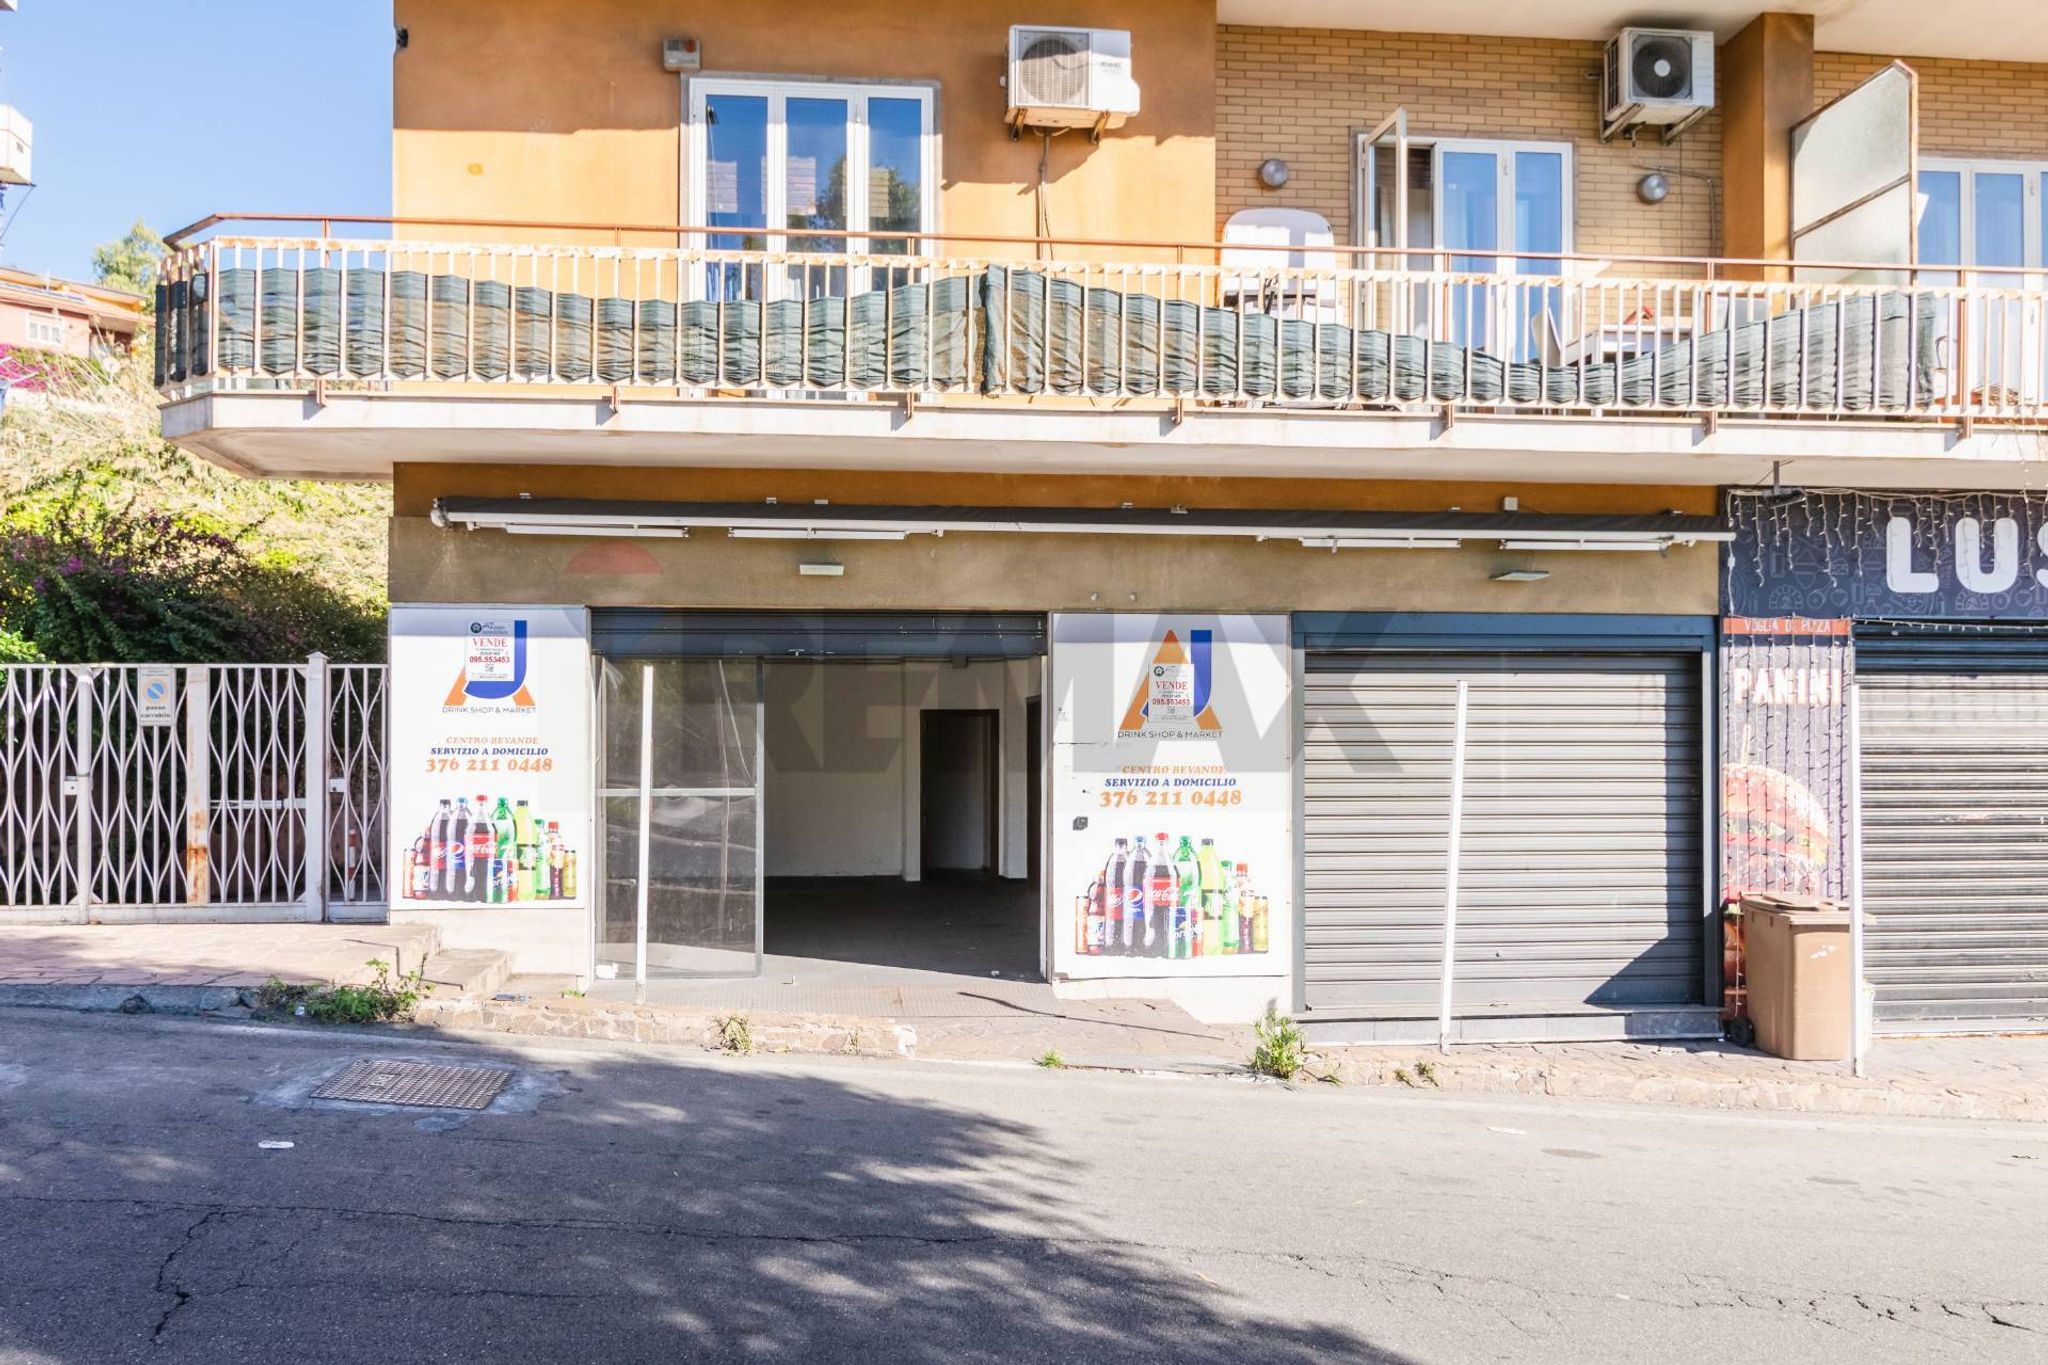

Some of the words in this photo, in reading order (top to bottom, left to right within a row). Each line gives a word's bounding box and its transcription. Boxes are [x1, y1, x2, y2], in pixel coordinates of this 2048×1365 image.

[1886, 516, 2048, 593] LU
[472, 637, 508, 647] VENDE
[1155, 681, 1188, 690] VENDE
[1734, 667, 1841, 704] PANINI
[442, 706, 468, 714] DRINK
[470, 706, 494, 714] SHOP
[495, 706, 501, 714] &
[502, 706, 537, 714] MARKET
[1117, 730, 1146, 739] DRINK
[1148, 730, 1176, 739] SHOP
[1176, 730, 1183, 739] &
[1185, 730, 1222, 739] MARKET
[446, 736, 488, 744] CENTRO
[490, 736, 539, 744] BEVANDE
[430, 747, 479, 755] SERVIZIO
[481, 747, 489, 755] A
[492, 747, 549, 755] DOMICILIO
[425, 757, 460, 772] 376
[466, 758, 500, 771] 211
[507, 757, 553, 772] 0448
[1121, 765, 1169, 774] CENTRO
[1172, 765, 1226, 774] BEVANDE
[1104, 778, 1159, 787] SERVIZIO
[1162, 778, 1170, 787] A
[1173, 778, 1237, 787] DOMICILIO
[1099, 790, 1138, 808] 376
[1145, 790, 1183, 806] 211
[1190, 789, 1242, 807] 0448
